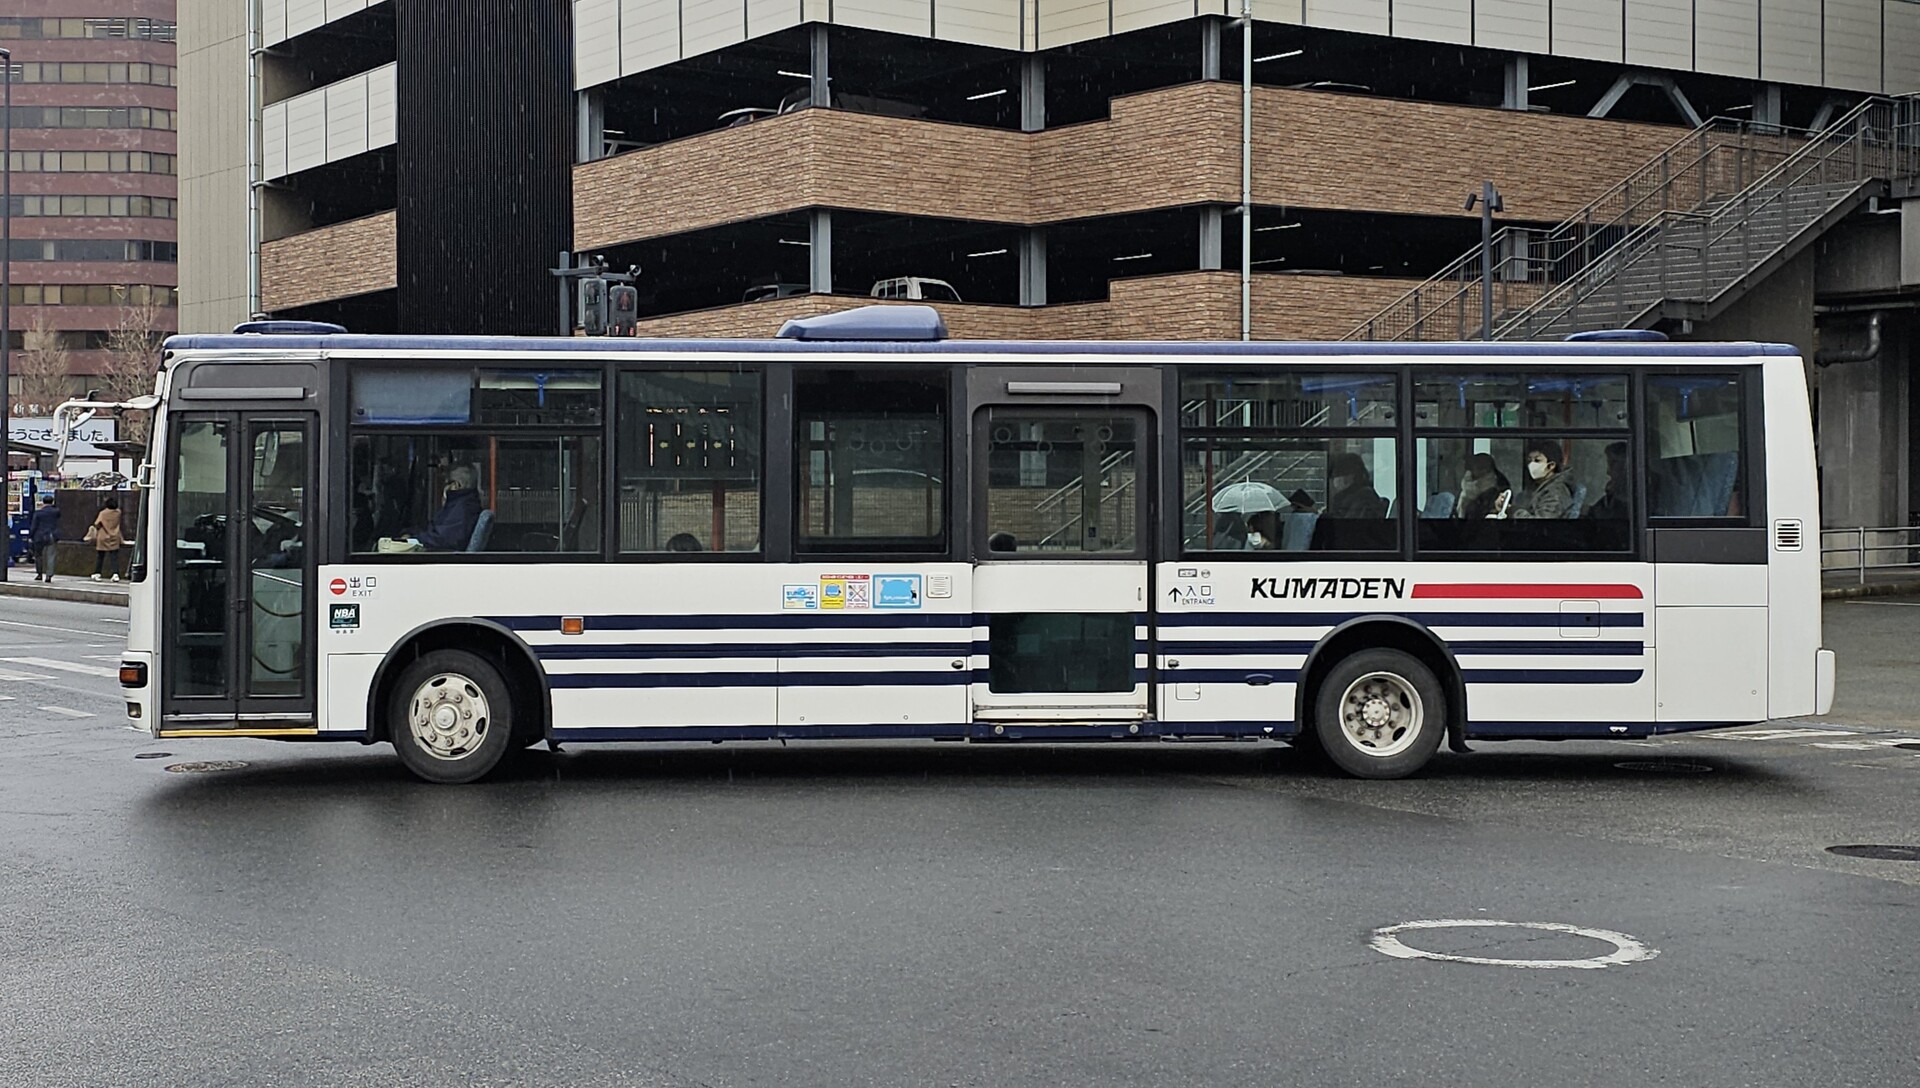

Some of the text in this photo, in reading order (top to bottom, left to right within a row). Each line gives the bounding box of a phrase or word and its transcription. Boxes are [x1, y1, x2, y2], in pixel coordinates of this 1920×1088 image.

[349, 576, 377, 589] 出口
[1250, 578, 1405, 599] KUMADEN
[1185, 585, 1212, 597] 入口
[1182, 597, 1215, 605] ENTRANCE
[334, 608, 356, 619] NBA
